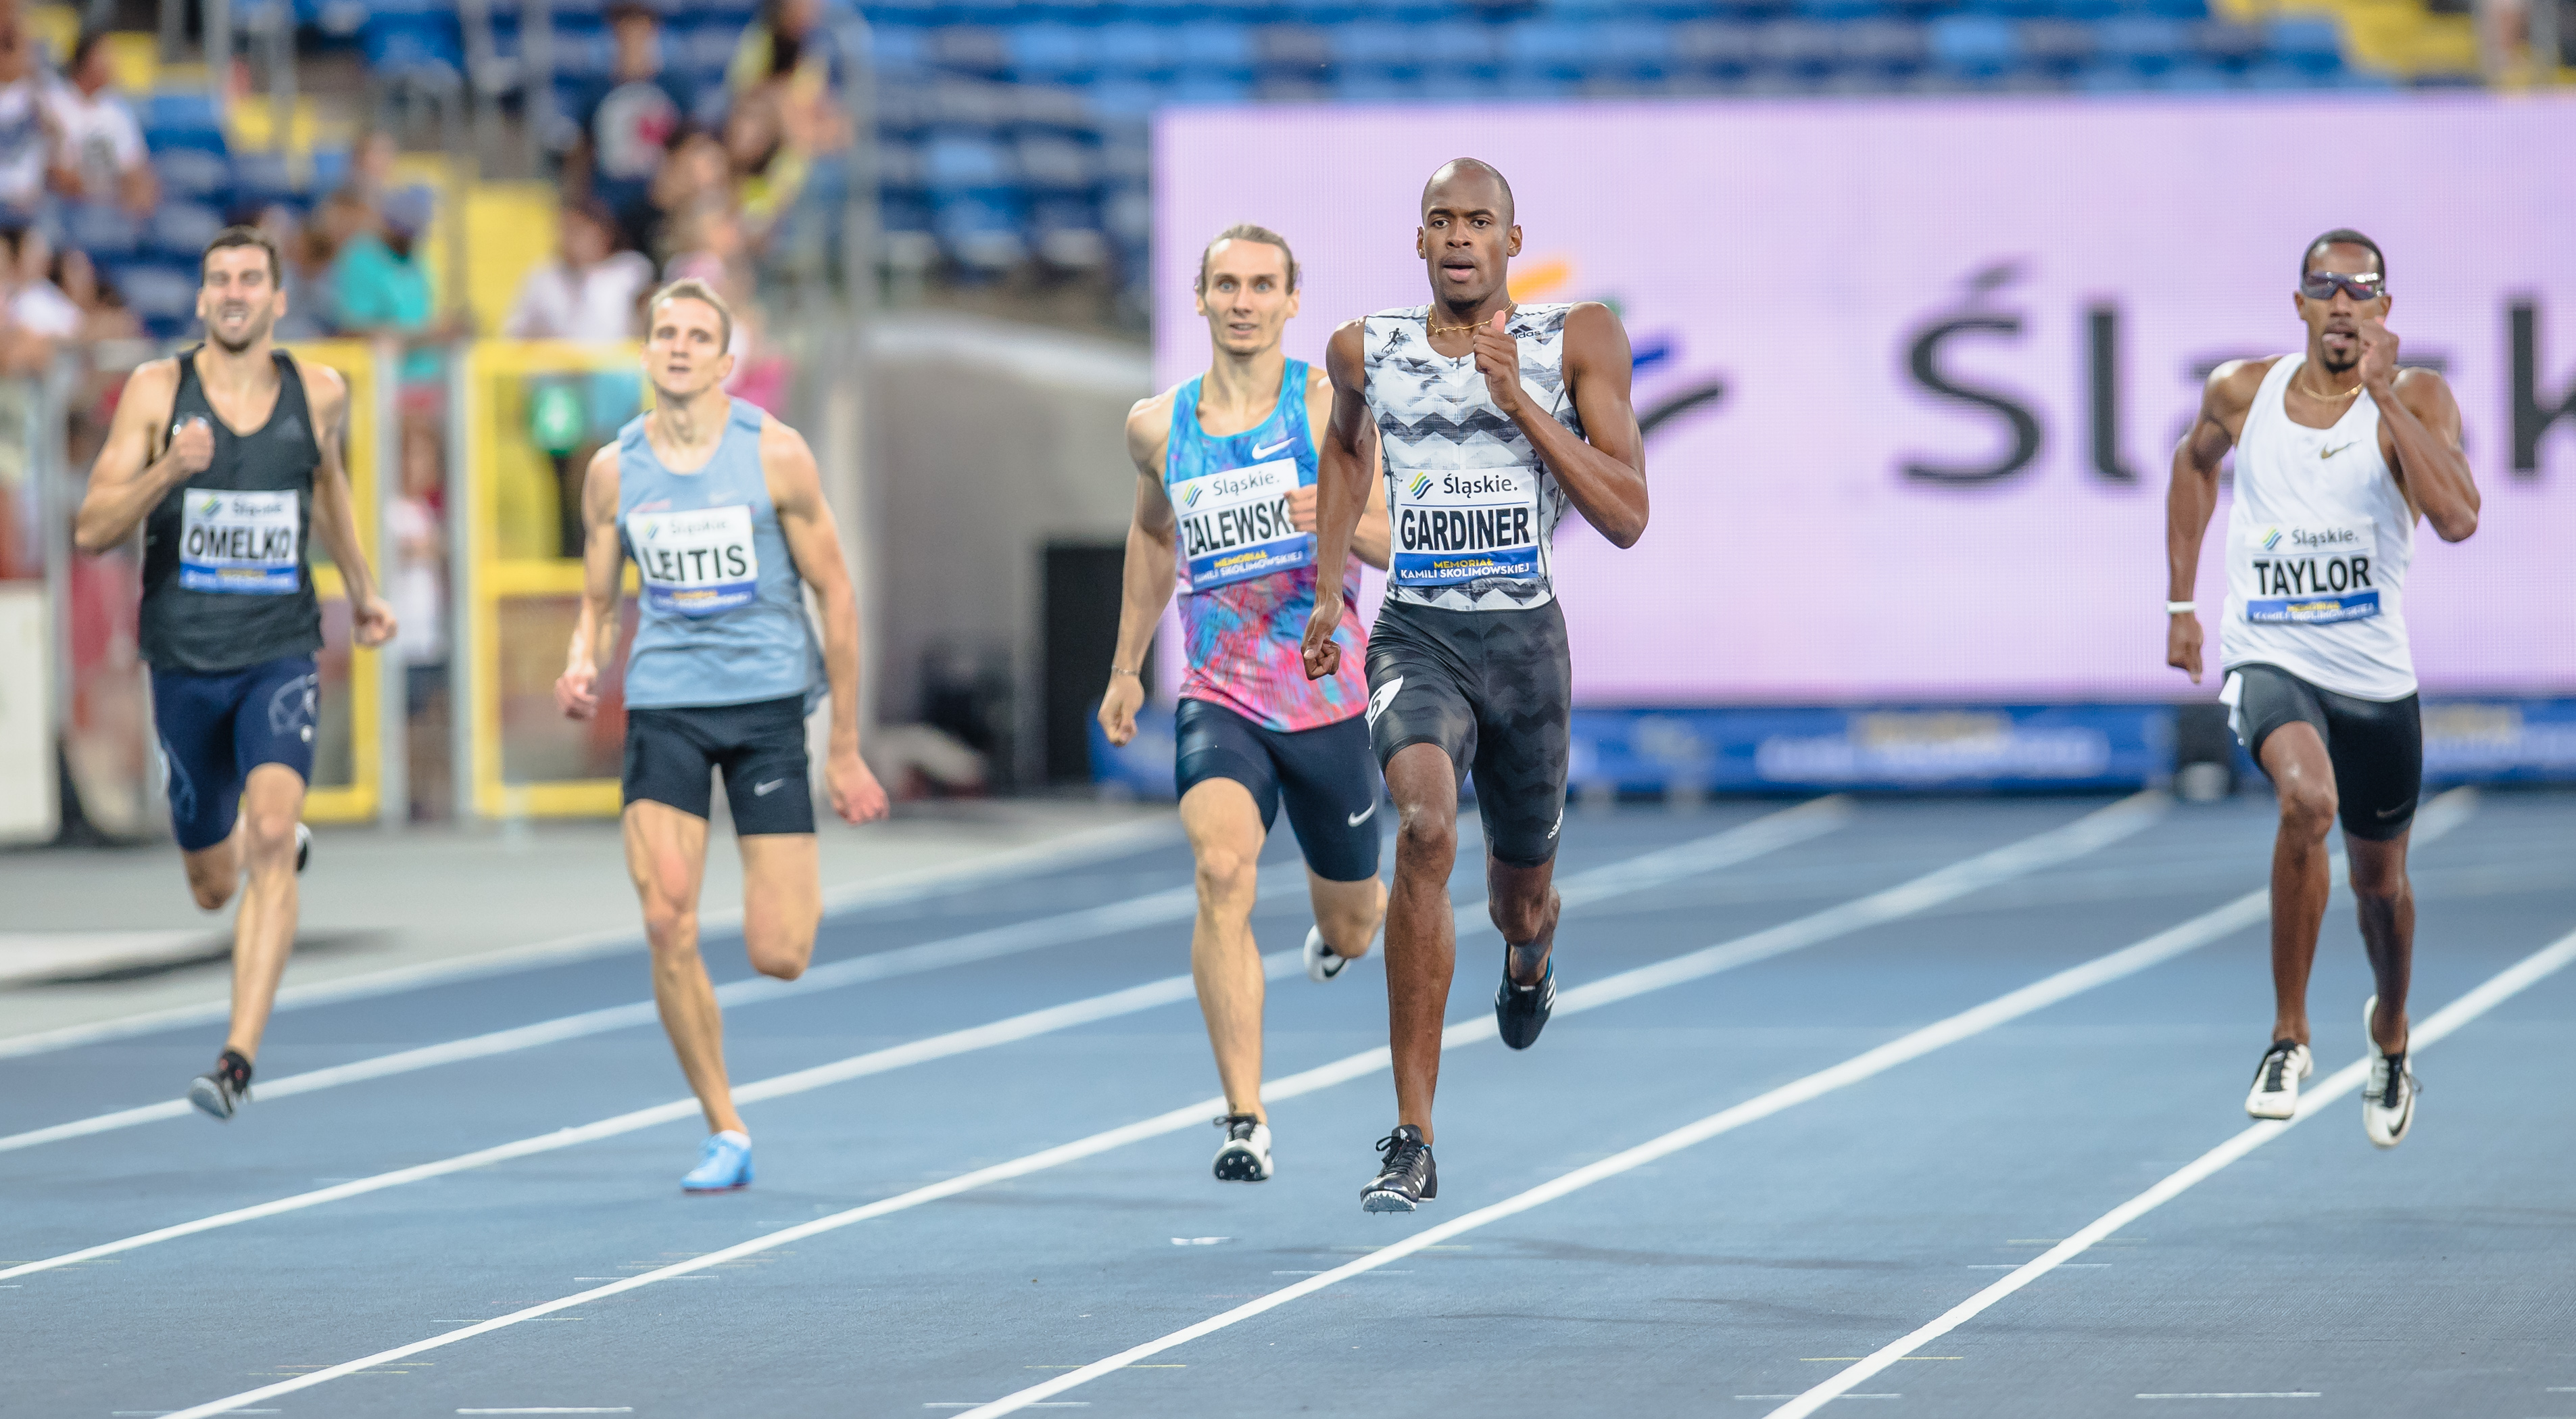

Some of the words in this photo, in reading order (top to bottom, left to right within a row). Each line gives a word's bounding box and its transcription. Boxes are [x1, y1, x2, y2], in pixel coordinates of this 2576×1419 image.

[1512, 331, 1541, 339] idas
[1898, 260, 2576, 487] Ślk
[1213, 471, 1280, 496] Śląskie.
[1443, 473, 1518, 498] Śląskie.
[188, 523, 293, 560] OMELKO
[1184, 498, 1296, 556] ZALEWSK
[1401, 507, 1530, 551] GARDINER
[643, 544, 748, 581] LEITIS
[1401, 569, 1437, 579] KAMILI
[1440, 562, 1530, 578] SKOLIMOWSKIEJ
[1434, 558, 1494, 569] MEMORIAŁ
[2252, 554, 2372, 595] TAYLOR
